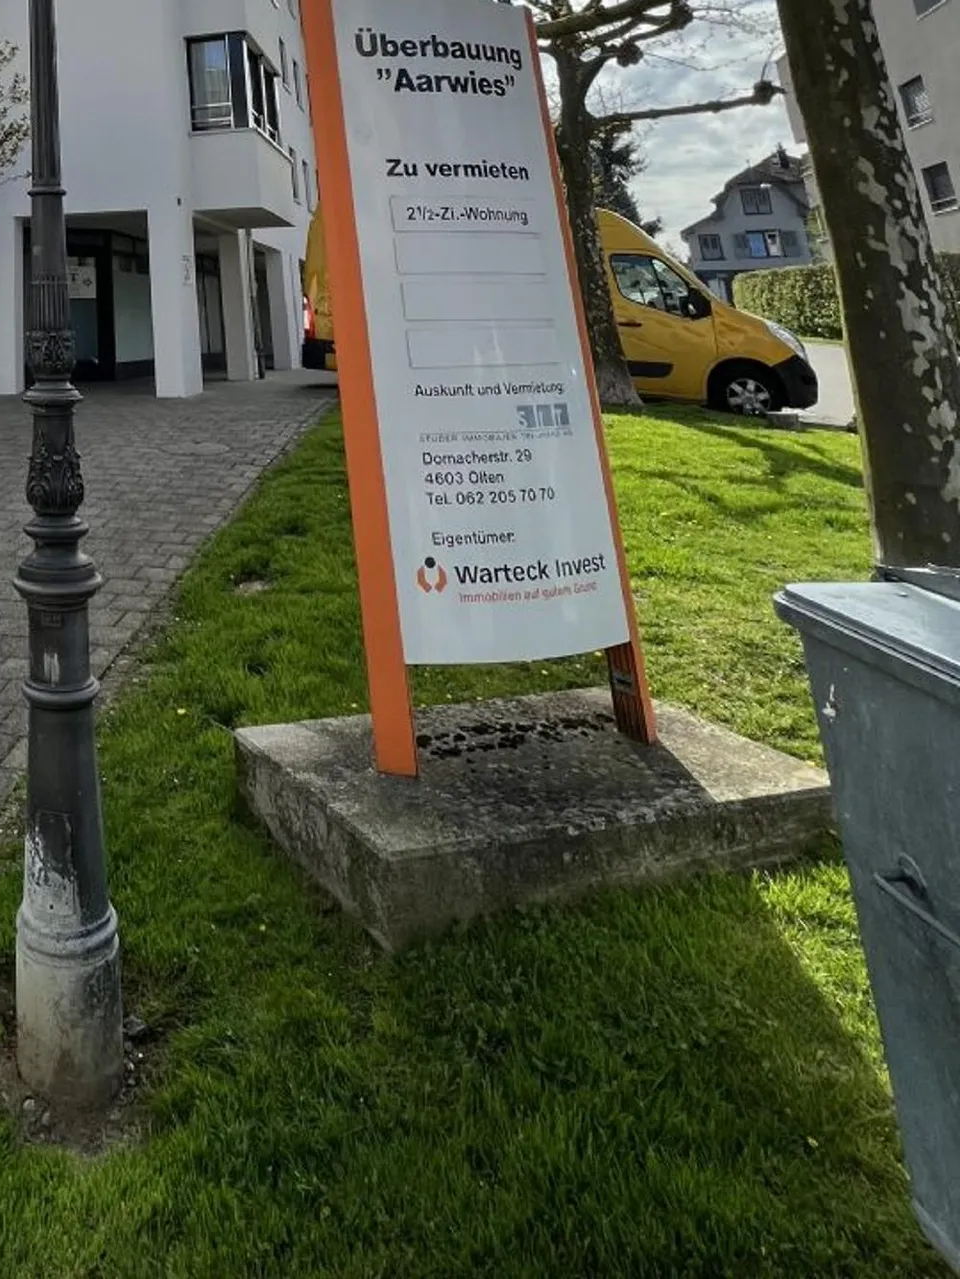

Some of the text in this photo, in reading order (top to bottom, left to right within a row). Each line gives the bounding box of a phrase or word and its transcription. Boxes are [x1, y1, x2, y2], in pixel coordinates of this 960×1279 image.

[355, 27, 522, 70] Überbauung
[386, 158, 529, 180] Zu vermieten
[415, 383, 474, 397] Auskunft
[477, 382, 502, 396] und
[422, 448, 533, 465] Dornacherstr. 29
[424, 470, 504, 485] 4603 Olten
[425, 486, 556, 505] Tel. 062 205 70 70
[454, 553, 606, 584] Warteck Invest
